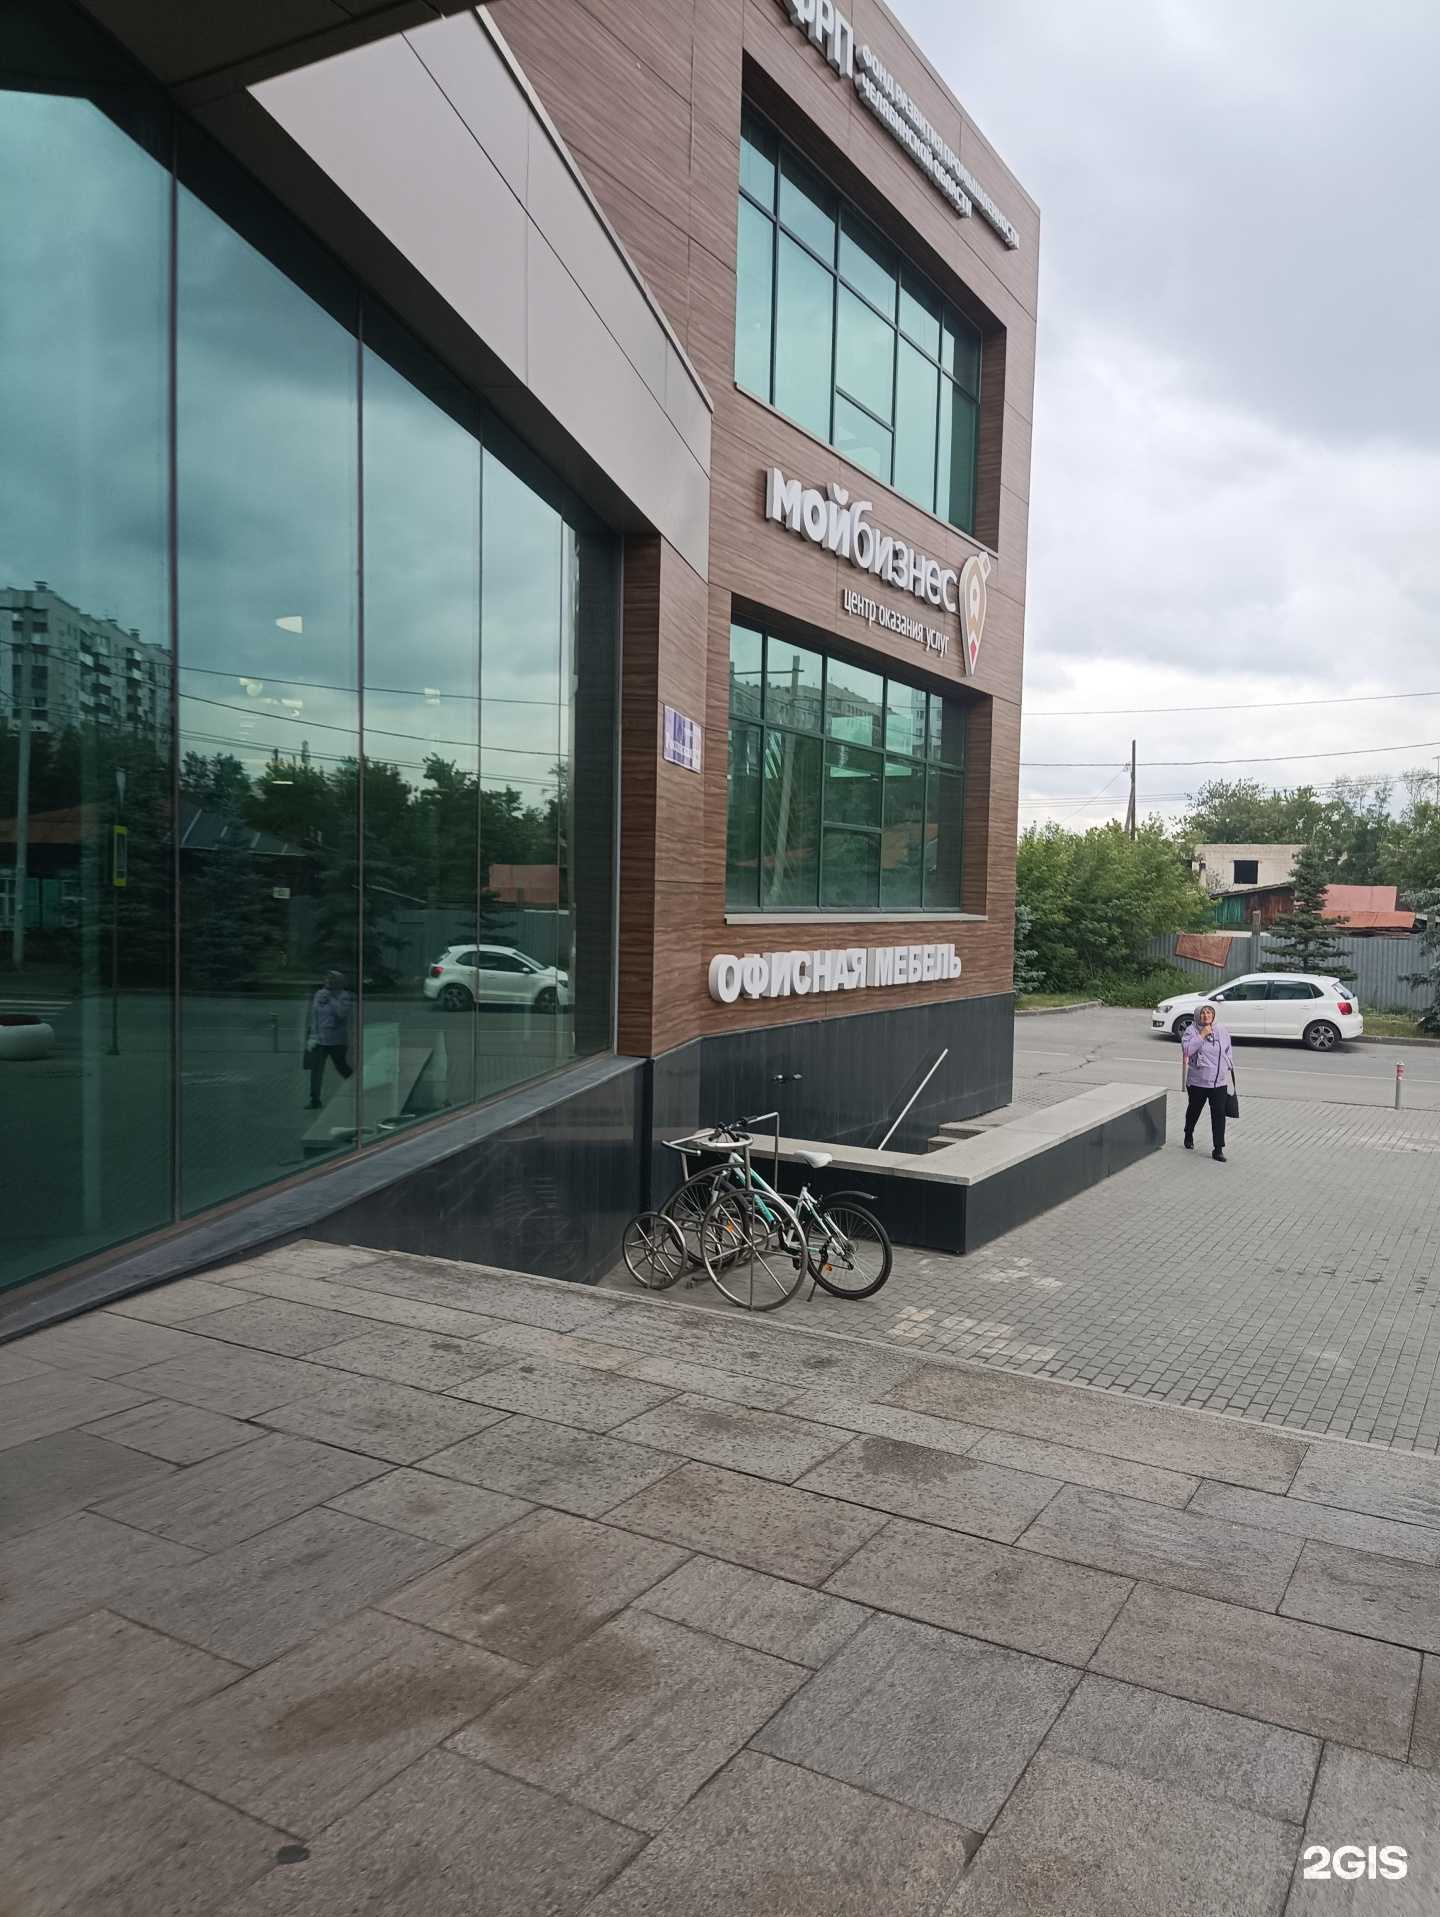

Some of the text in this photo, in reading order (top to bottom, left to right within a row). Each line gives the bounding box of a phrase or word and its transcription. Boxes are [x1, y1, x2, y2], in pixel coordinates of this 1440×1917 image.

[933, 159, 972, 217] ОБЛАСТИ
[844, 588, 950, 658] центр оказания услуг
[709, 943, 962, 1003] ОФИСНАЯ МЕБЕЛЬ
